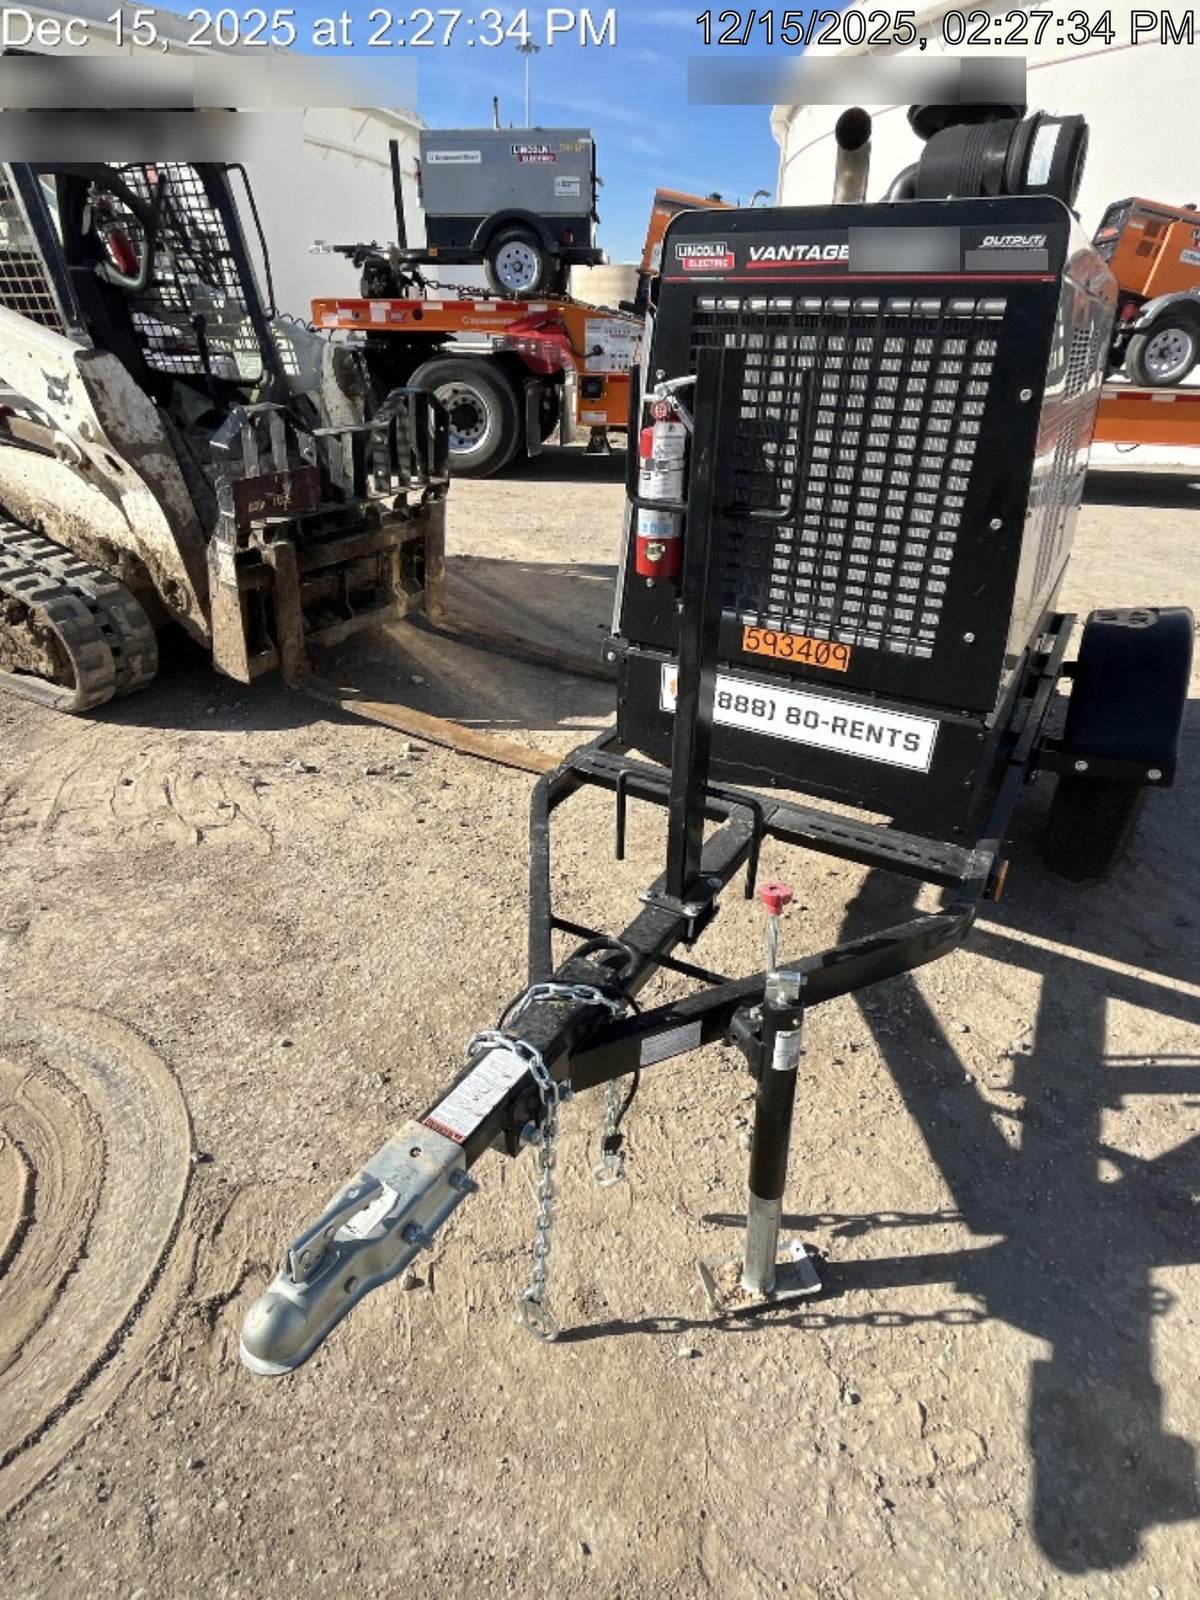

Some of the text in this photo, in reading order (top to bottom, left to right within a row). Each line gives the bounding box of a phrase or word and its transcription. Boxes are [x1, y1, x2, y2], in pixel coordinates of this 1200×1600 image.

[678, 246, 725, 257] LINCOLN
[749, 245, 849, 261] VANTAGE
[688, 259, 729, 268] ELECTRIC
[746, 628, 849, 669] 593409
[717, 690, 921, 753] 888) 80-RENTS
